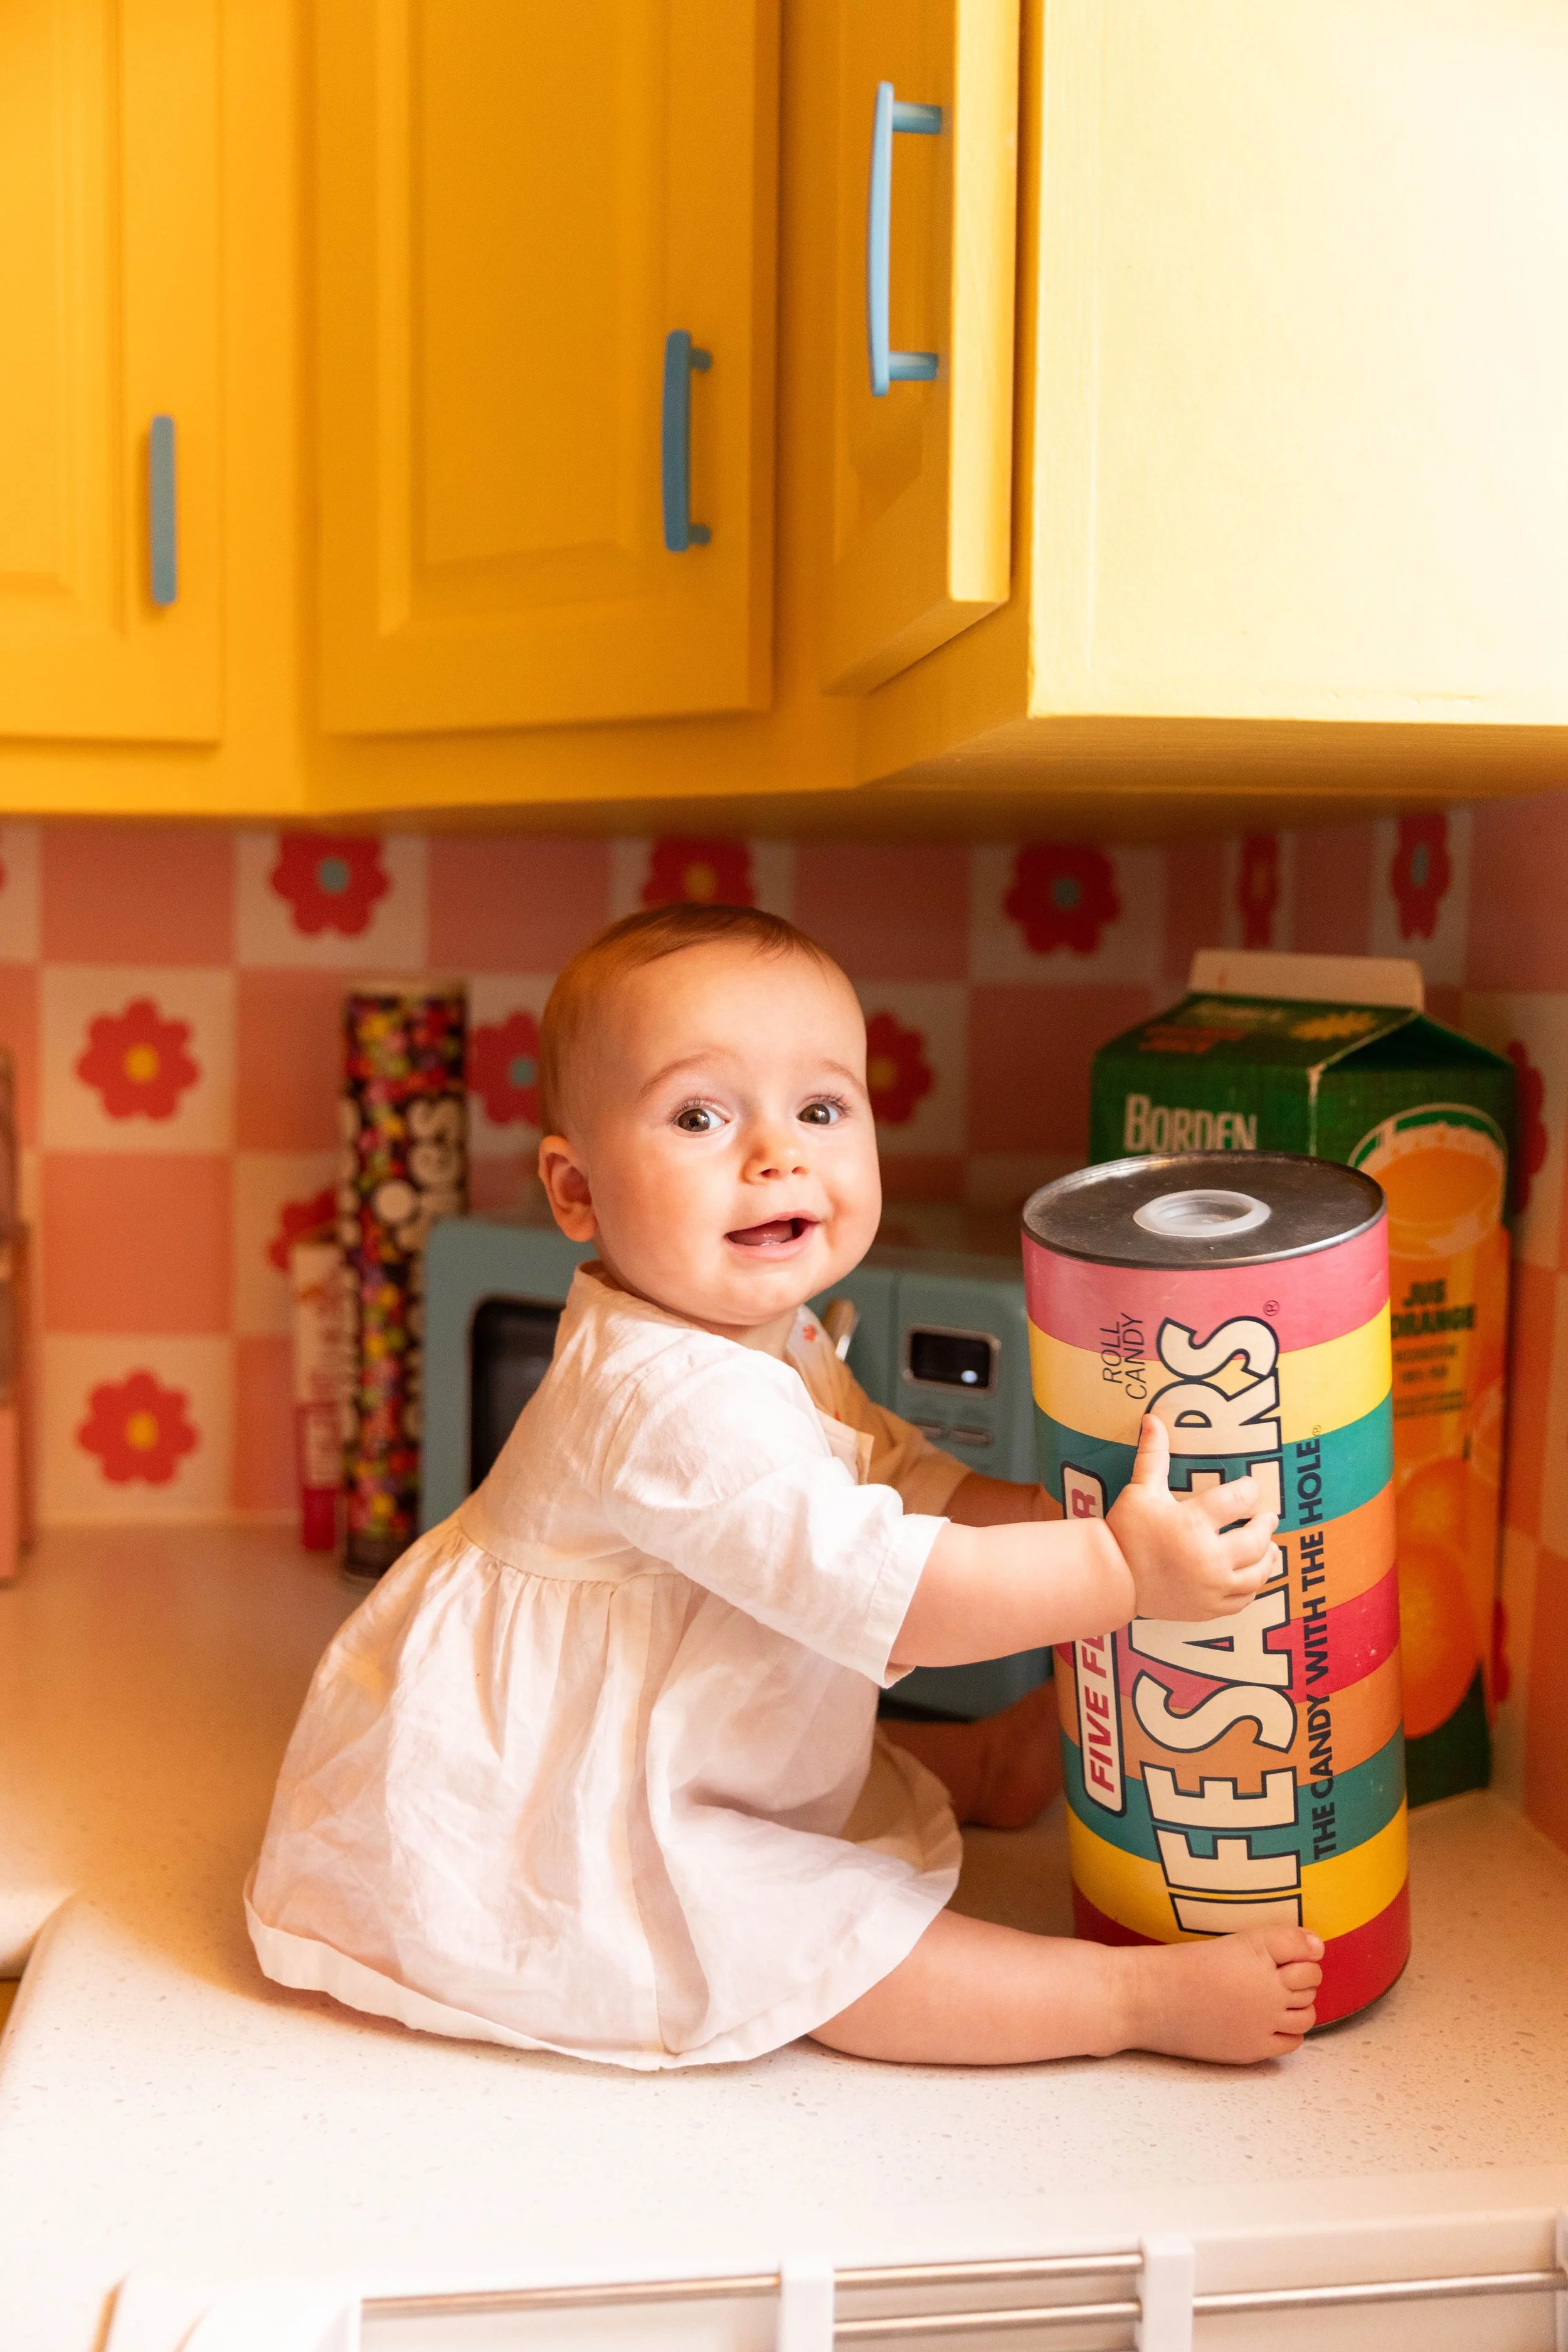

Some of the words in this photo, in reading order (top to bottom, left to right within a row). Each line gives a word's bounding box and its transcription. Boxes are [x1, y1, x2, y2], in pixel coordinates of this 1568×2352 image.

[1124, 1093, 1257, 1152] BORDEN
[1099, 1321, 1123, 1384] ROLL
[1120, 1312, 1148, 1400] CANDY
[1296, 1438, 1323, 1526] HOLE
[1300, 1531, 1326, 1592] THE
[1302, 1596, 1330, 1686] WITH
[1084, 1687, 1115, 1793] FIVE
[1307, 1693, 1334, 1799] CANDY
[1140, 1760, 1303, 1936] IFE
[1311, 1801, 1337, 1860] THE
